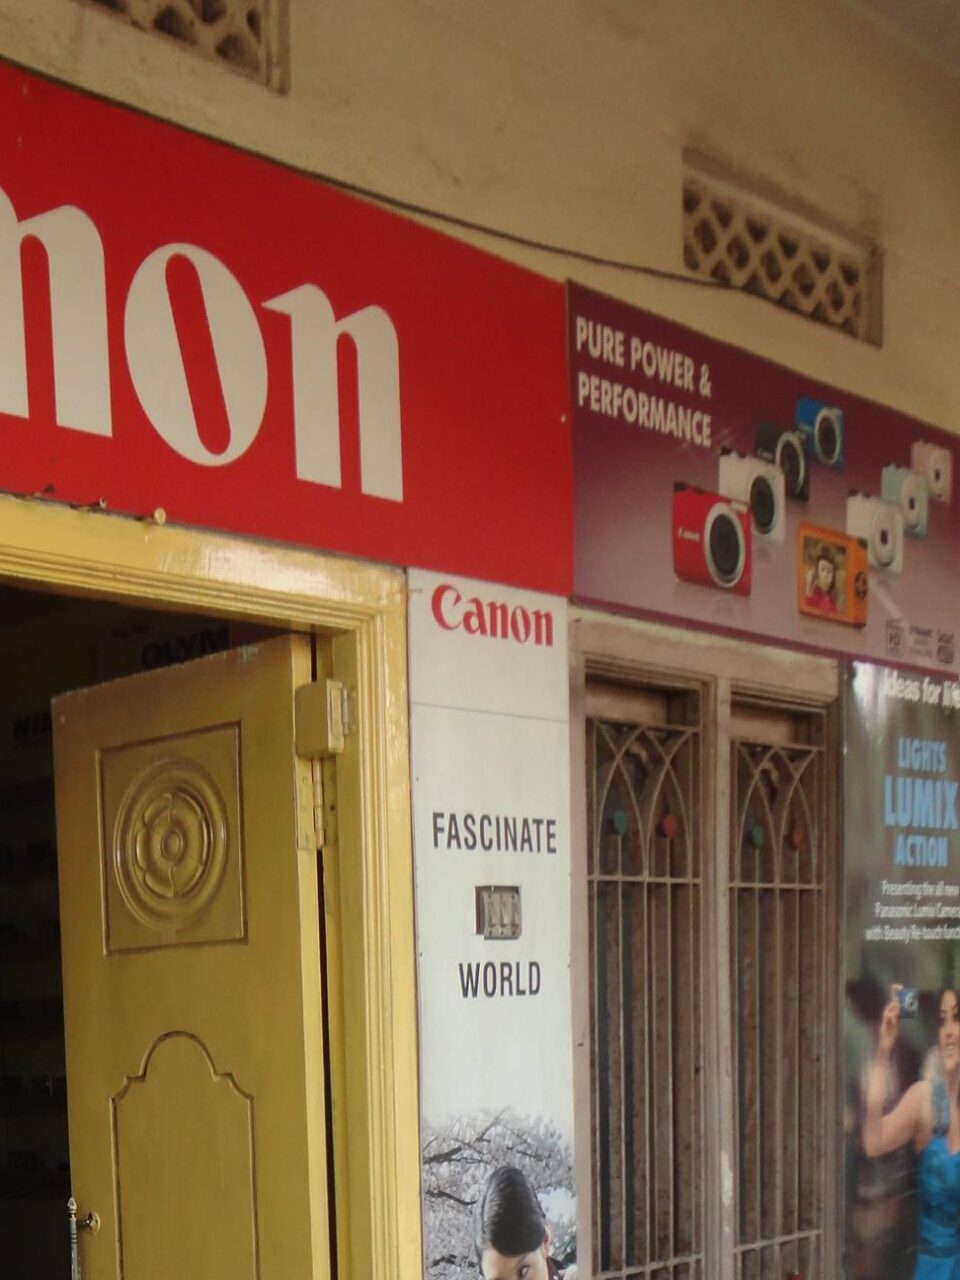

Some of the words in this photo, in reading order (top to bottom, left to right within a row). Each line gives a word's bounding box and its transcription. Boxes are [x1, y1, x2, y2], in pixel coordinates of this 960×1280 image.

[575, 316, 625, 367] PURE
[631, 336, 695, 394] POWER
[699, 362, 713, 398] &
[577, 371, 713, 448] PERFORMANCE
[431, 584, 554, 647] Canon
[898, 737, 947, 773] LIGHTS
[884, 775, 960, 830] LUMIX
[432, 812, 558, 854] FASCINATE
[895, 833, 948, 867] ACTION
[459, 962, 541, 998] WORLD
